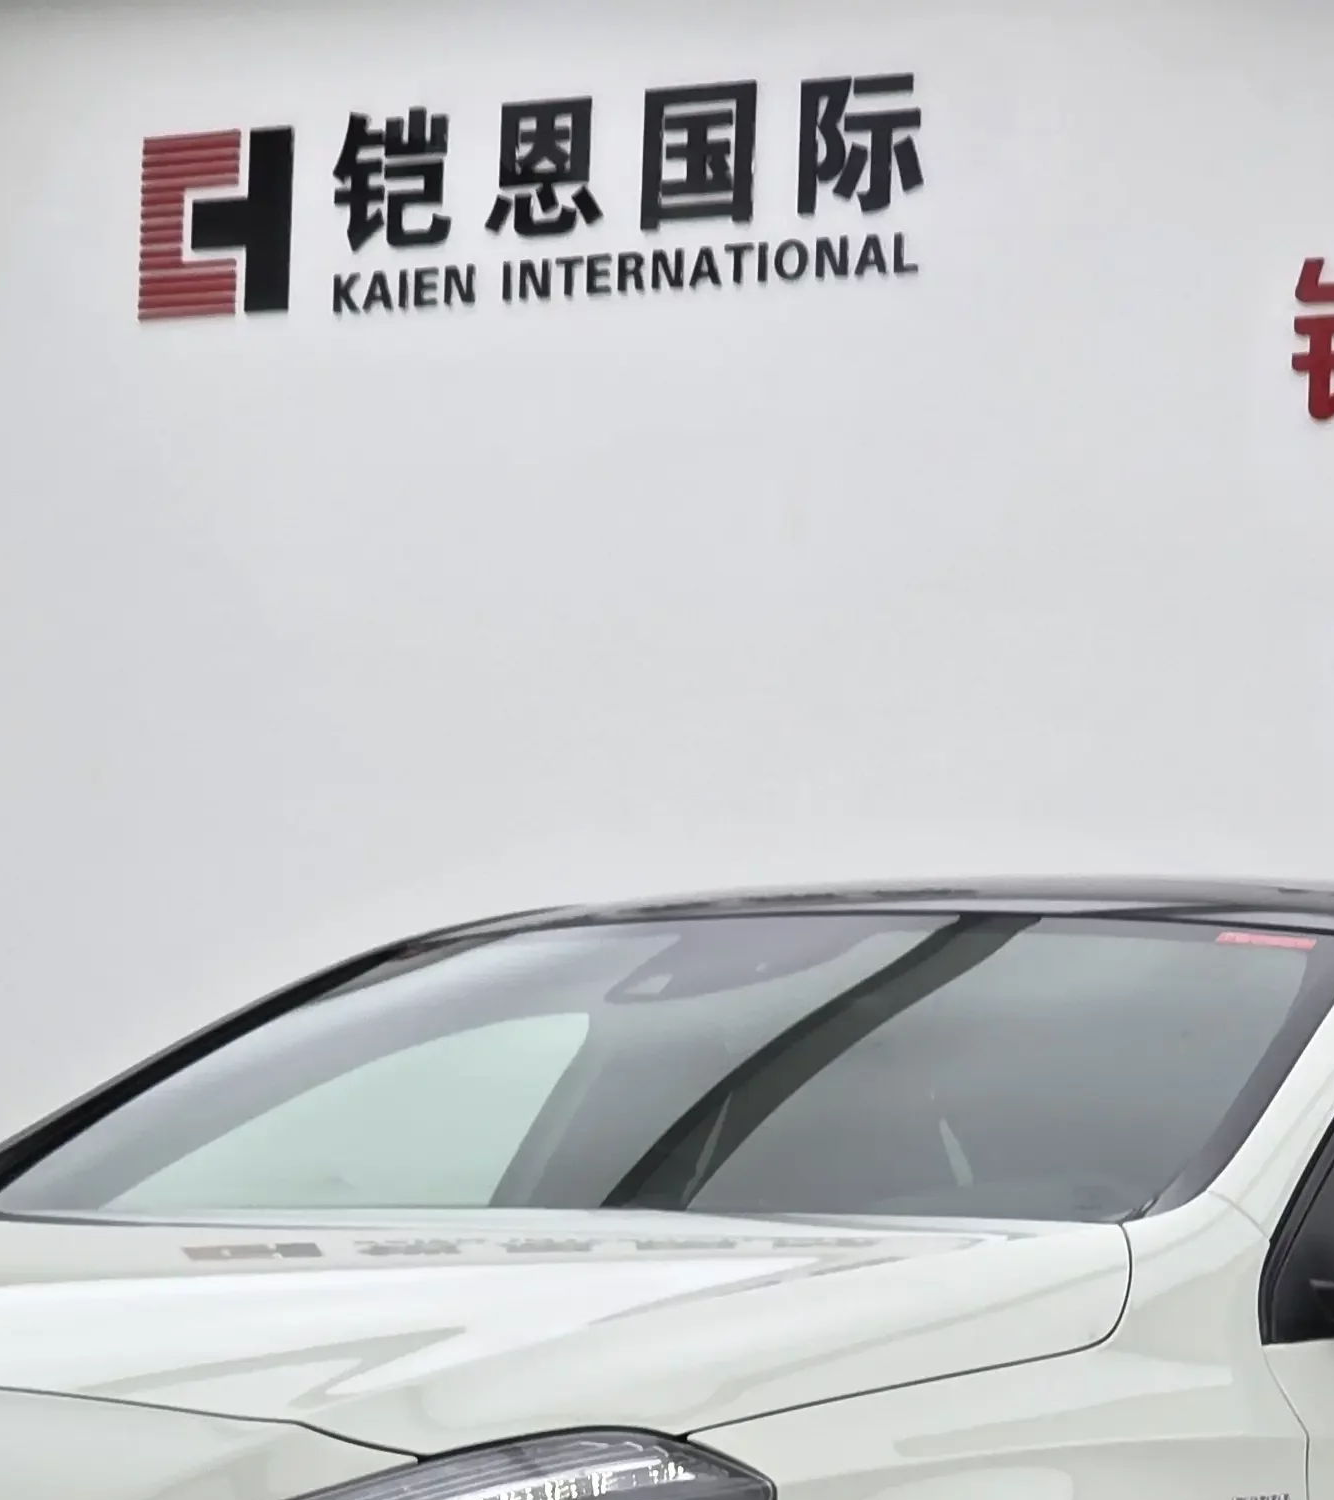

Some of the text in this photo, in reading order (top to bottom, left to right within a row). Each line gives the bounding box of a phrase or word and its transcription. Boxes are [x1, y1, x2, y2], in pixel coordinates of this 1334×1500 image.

[332, 73, 924, 252] 铠恩国际
[332, 232, 919, 315] KAIEN INTERNATIONAL
